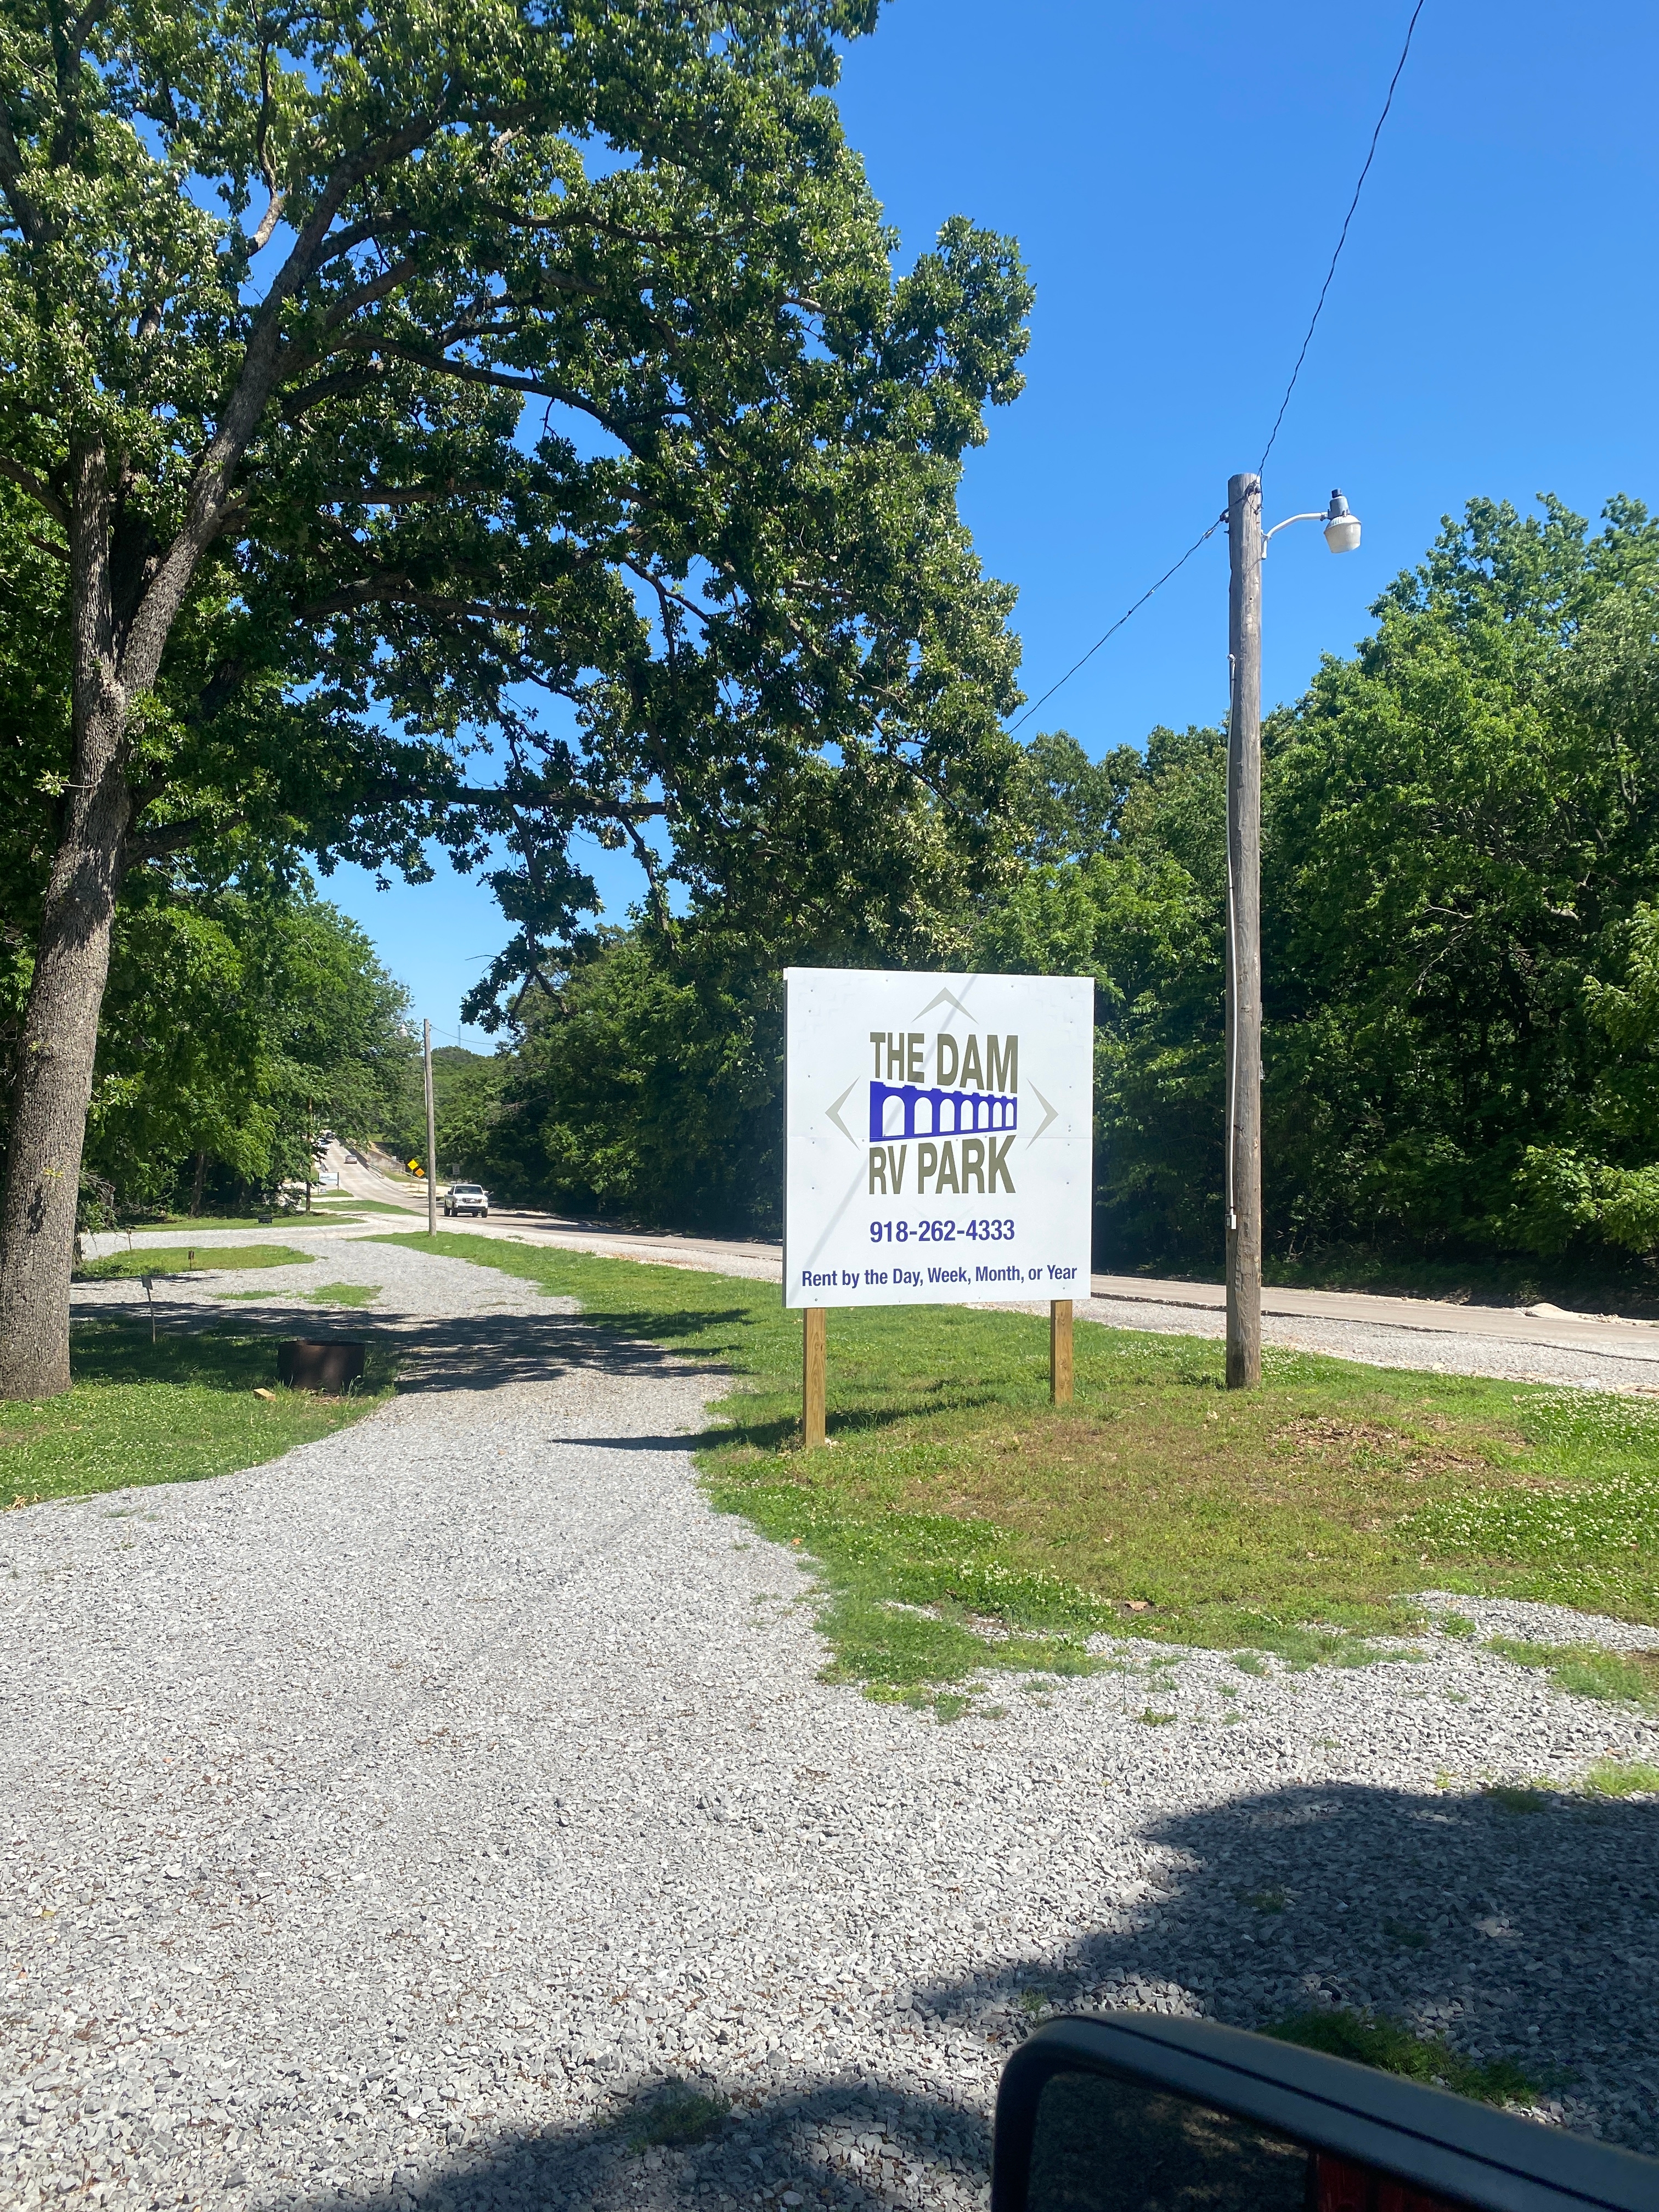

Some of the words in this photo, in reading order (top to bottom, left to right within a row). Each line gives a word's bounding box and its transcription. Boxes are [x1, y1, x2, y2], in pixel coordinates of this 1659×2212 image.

[870, 1032, 924, 1084] THE
[936, 1033, 1018, 1094] DAM
[869, 1144, 907, 1195] RV
[918, 1135, 1017, 1194] PARK
[870, 1219, 1015, 1243] 918-262-4333
[802, 1270, 838, 1286] Rent
[842, 1269, 860, 1289] by
[864, 1269, 888, 1285] the
[893, 1268, 923, 1287] Day,
[927, 1266, 971, 1285] Week,
[975, 1265, 1024, 1284] Month,
[1028, 1268, 1043, 1280] or
[1047, 1264, 1077, 1280] Year
